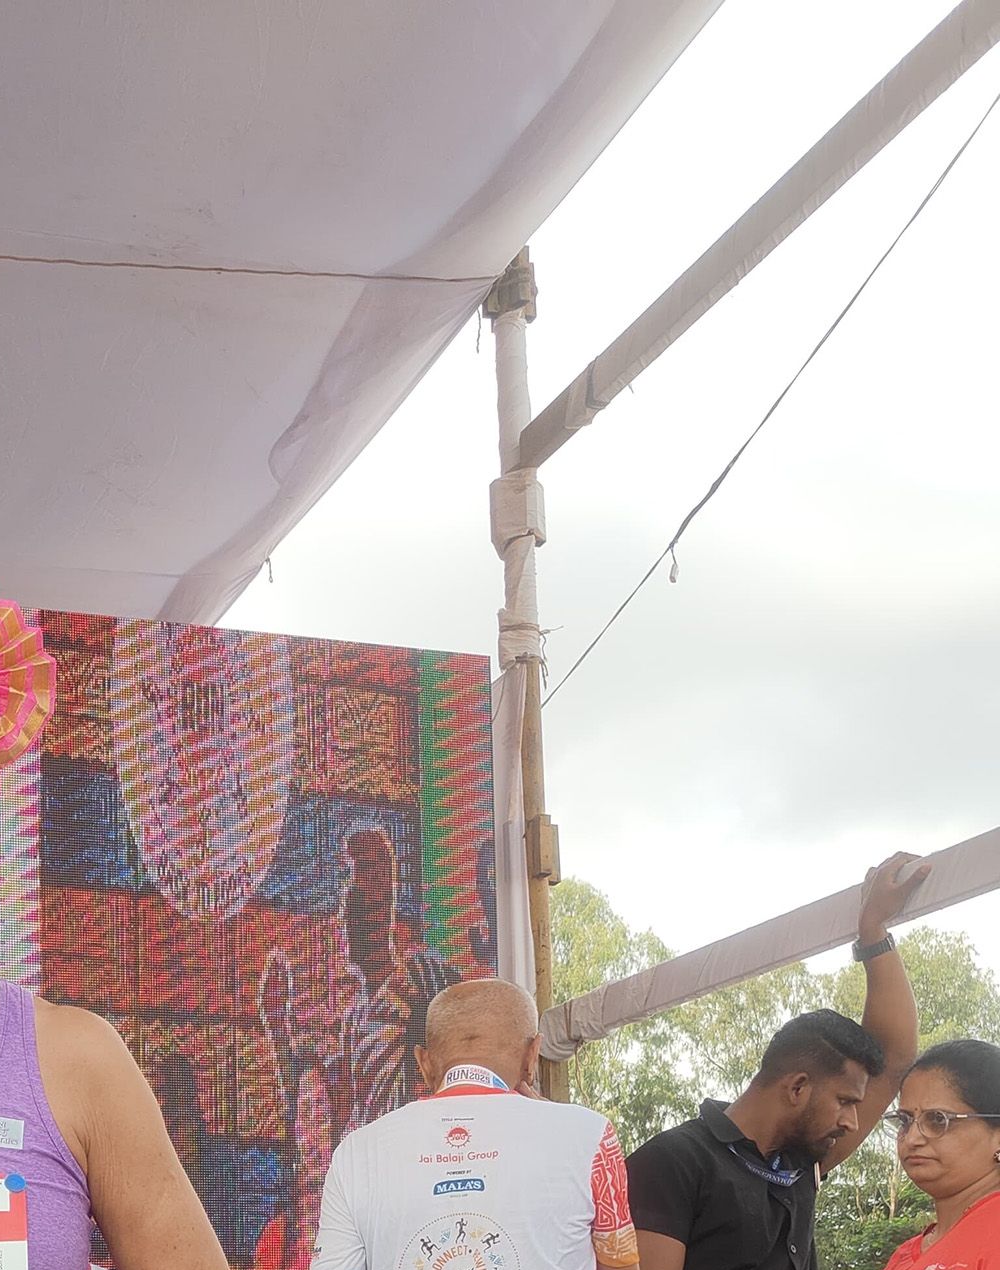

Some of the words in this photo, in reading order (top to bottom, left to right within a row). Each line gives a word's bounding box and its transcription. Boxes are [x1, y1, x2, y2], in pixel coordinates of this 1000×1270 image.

[446, 1069, 470, 1082] RUN
[419, 1154, 433, 1163] Jai
[436, 1153, 464, 1164] Balaji
[467, 1150, 499, 1161] Group
[436, 1181, 482, 1193] MALA'S
